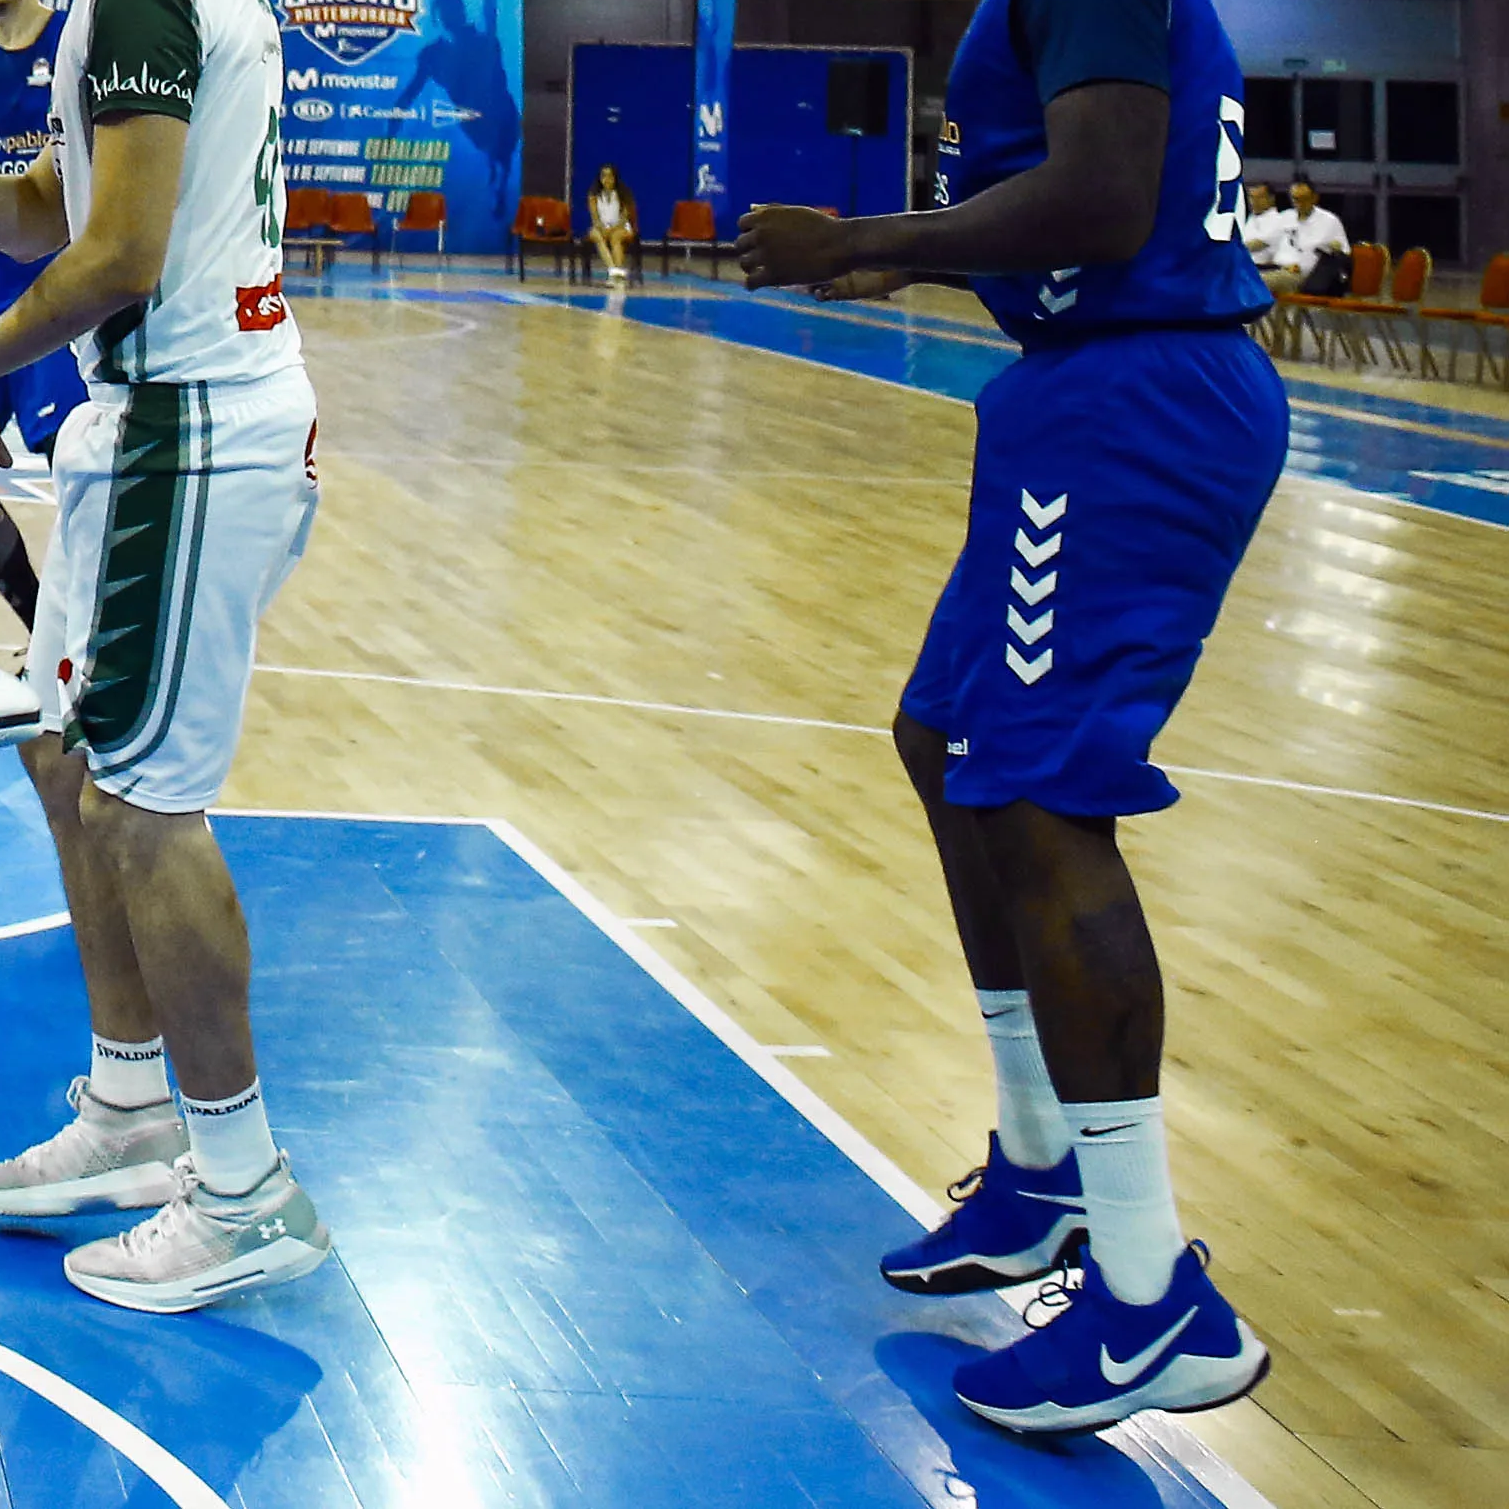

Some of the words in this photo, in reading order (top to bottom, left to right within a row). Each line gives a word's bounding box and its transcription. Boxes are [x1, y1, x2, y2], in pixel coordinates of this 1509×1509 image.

[294, 6, 405, 25] PRETEMPORADA
[322, 74, 398, 90] movistar
[97, 1043, 164, 1061] SPALDIN
[186, 1092, 259, 1116] SPALDIN
